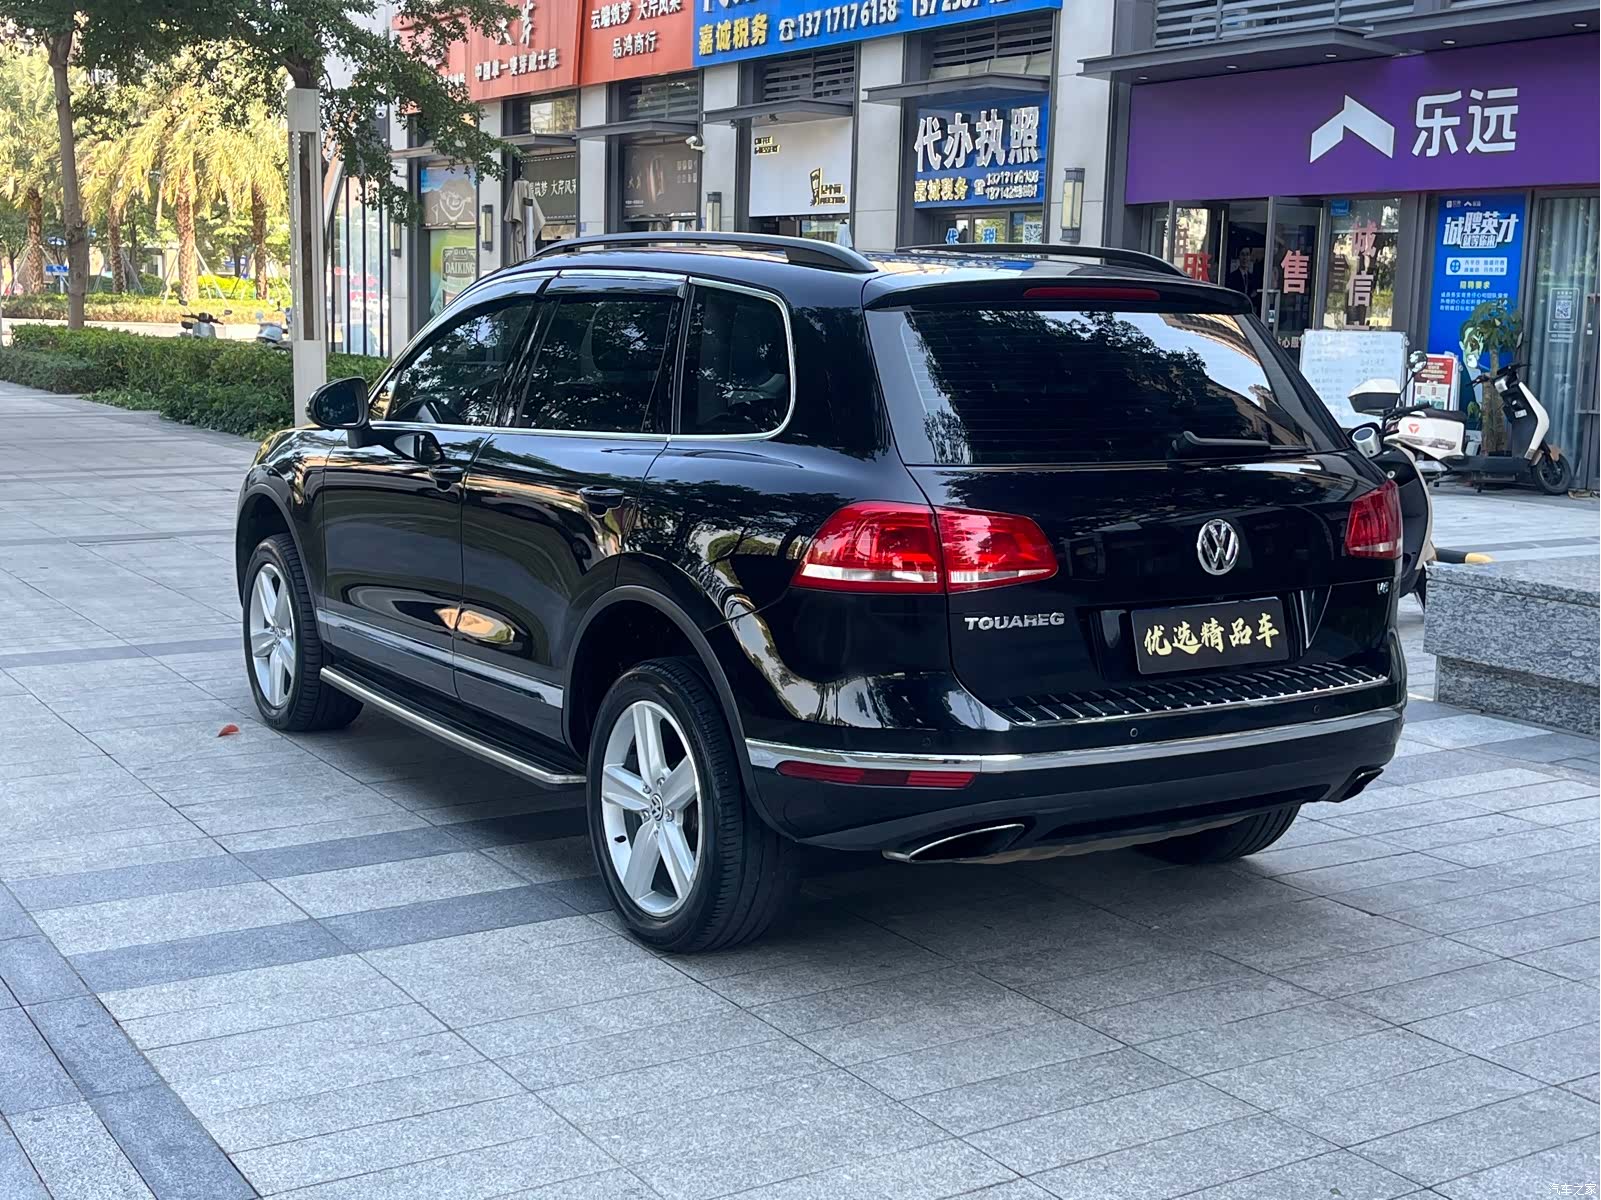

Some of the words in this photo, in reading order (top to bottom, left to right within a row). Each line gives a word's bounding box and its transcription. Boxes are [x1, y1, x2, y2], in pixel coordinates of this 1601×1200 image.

[914, 106, 1040, 173] 代办执照
[1411, 87, 1519, 157] 乐远
[1443, 211, 1519, 245] 诚聘英才
[1281, 250, 1310, 293] 售
[964, 612, 1065, 631] TOUAREG
[1144, 612, 1280, 656] 优选精品车
